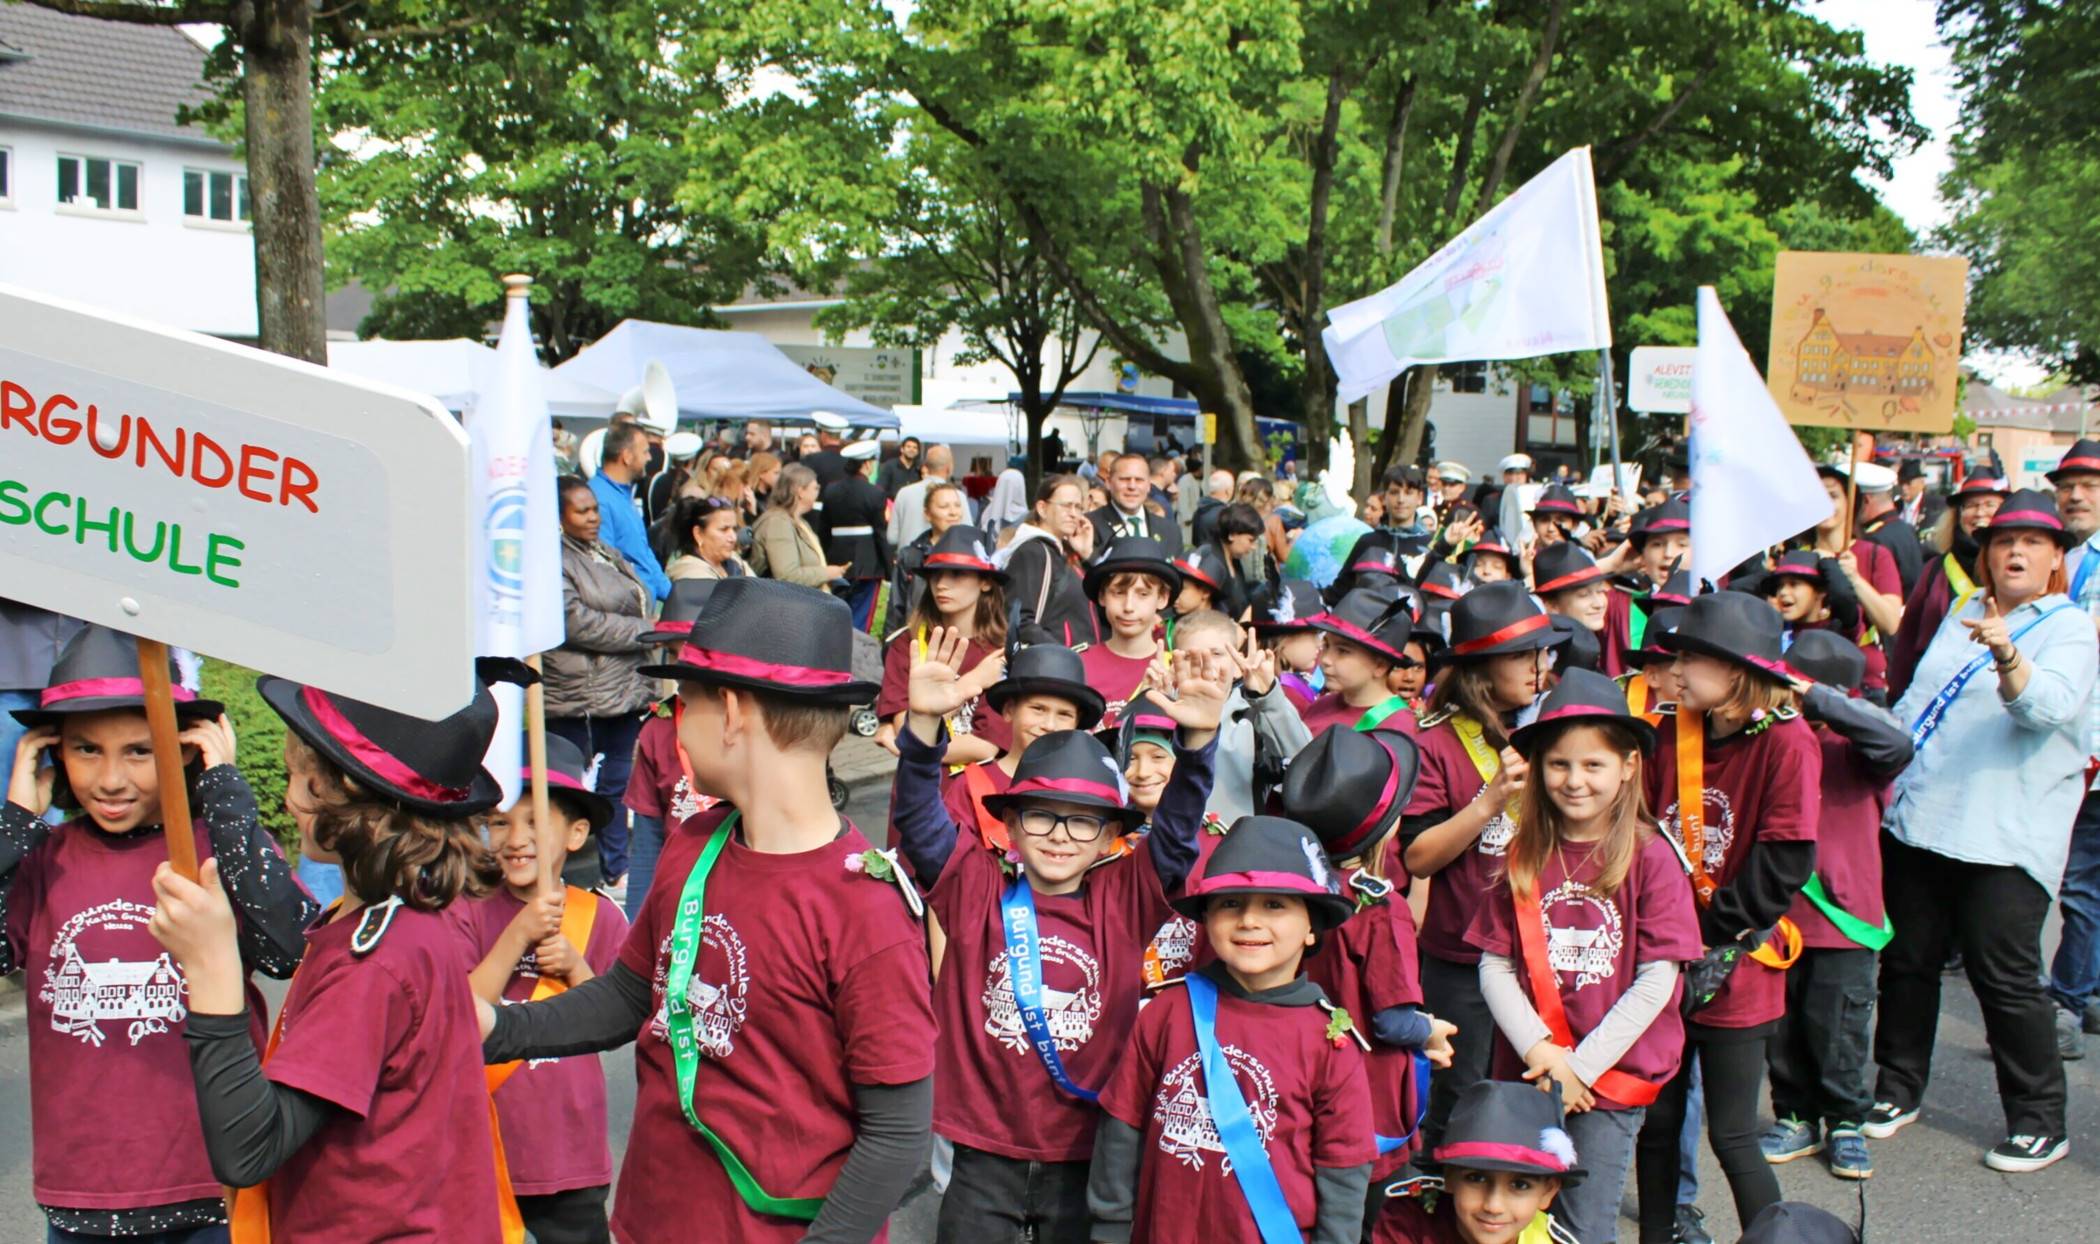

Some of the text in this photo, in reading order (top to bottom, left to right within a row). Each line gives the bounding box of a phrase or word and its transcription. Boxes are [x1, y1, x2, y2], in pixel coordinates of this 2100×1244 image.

[0, 380, 320, 513] RGUNDER
[0, 480, 246, 589] SCHULE
[1008, 906, 1038, 997] Burgund
[1023, 1003, 1044, 1031] ist
[676, 1027, 695, 1062] ist
